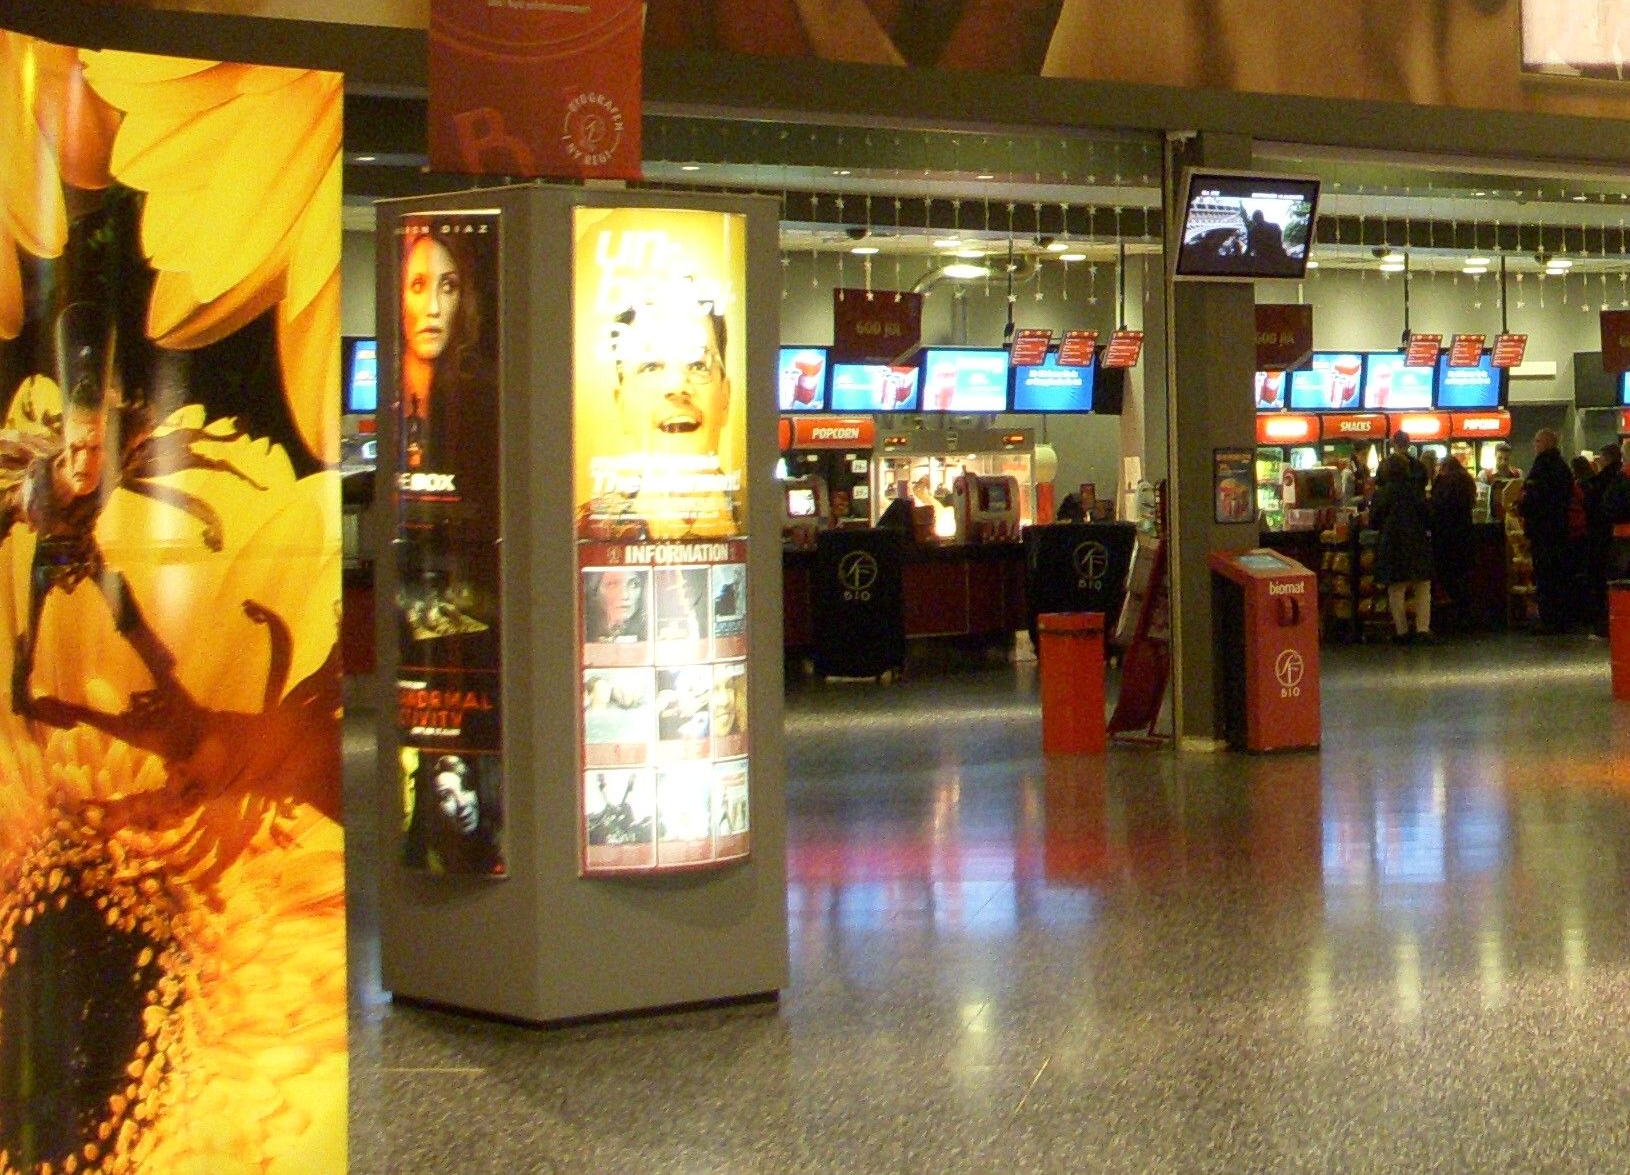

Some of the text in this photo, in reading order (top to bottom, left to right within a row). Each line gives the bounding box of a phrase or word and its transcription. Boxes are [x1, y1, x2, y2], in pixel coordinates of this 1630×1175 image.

[1340, 421, 1371, 432] SNACKS
[812, 427, 859, 440] POPCORN
[411, 473, 456, 491] BOX
[625, 544, 728, 563] INFORMATION
[1269, 581, 1305, 595] biomat
[1281, 687, 1300, 697] BIO
